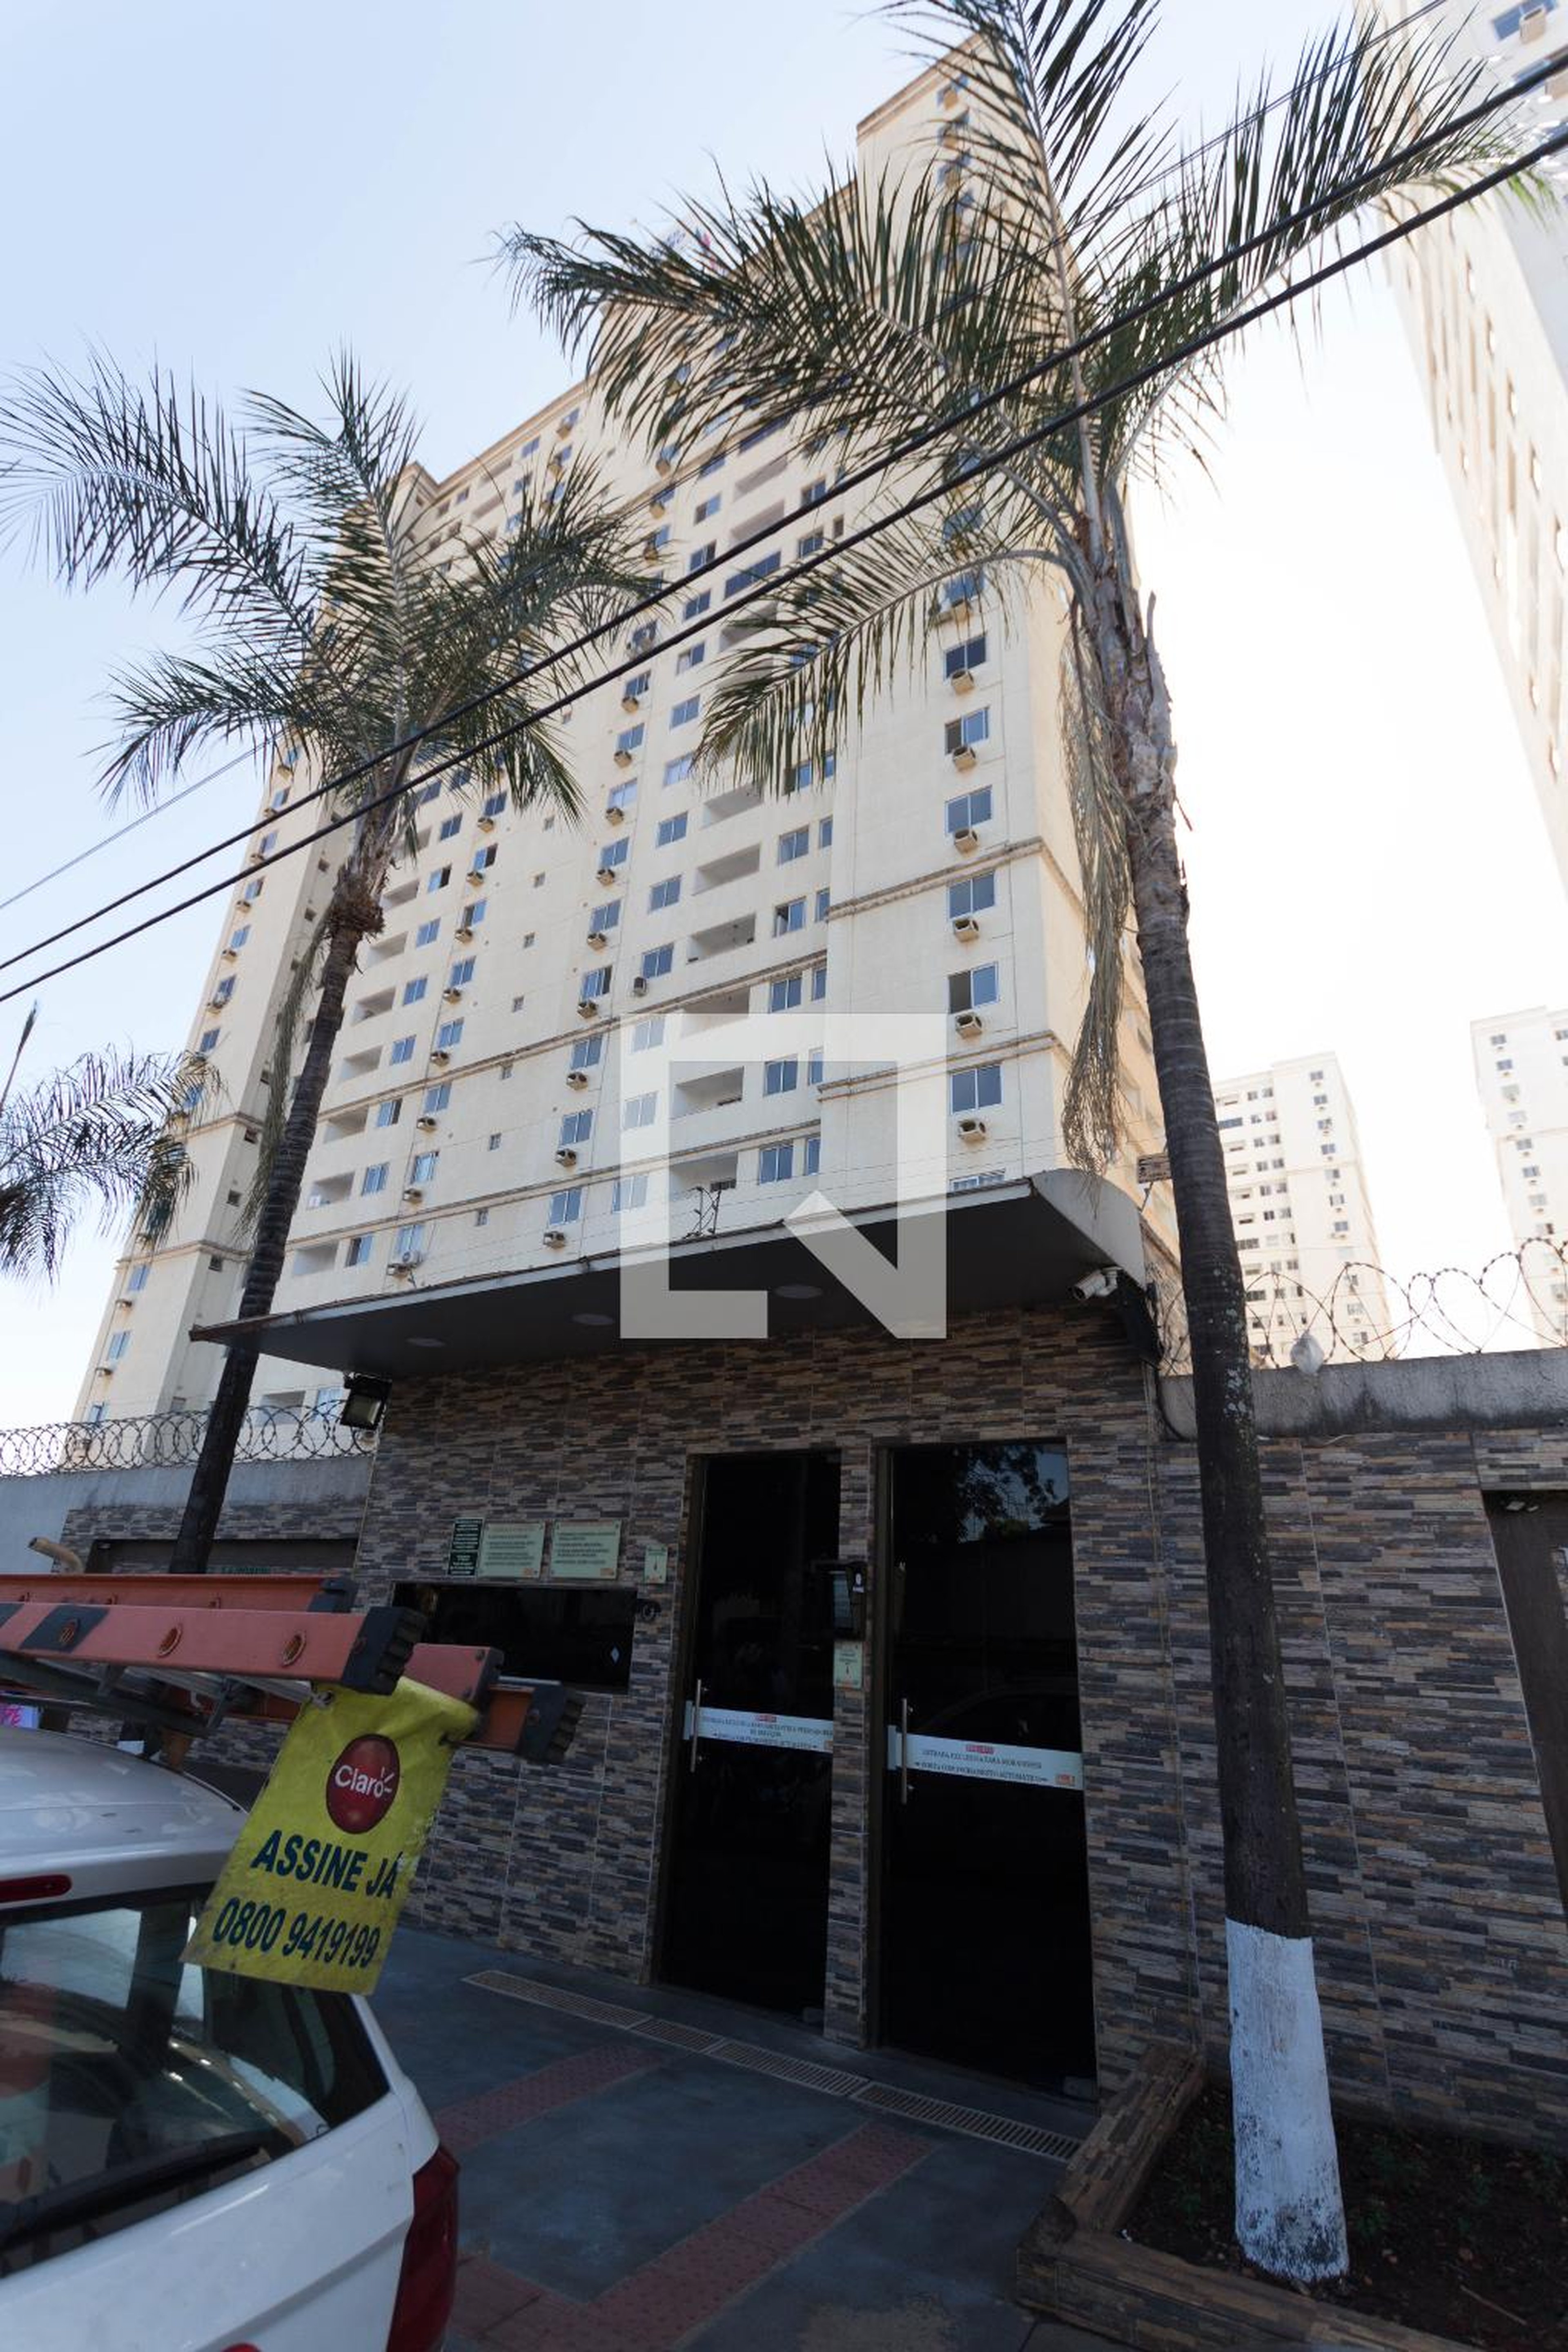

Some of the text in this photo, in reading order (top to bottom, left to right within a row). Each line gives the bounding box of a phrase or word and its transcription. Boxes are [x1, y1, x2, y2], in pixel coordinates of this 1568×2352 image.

[335, 1764, 384, 1798] Claro
[249, 1829, 403, 1900] ASSINE JÁ
[212, 1896, 381, 1969] 0800 9419199
